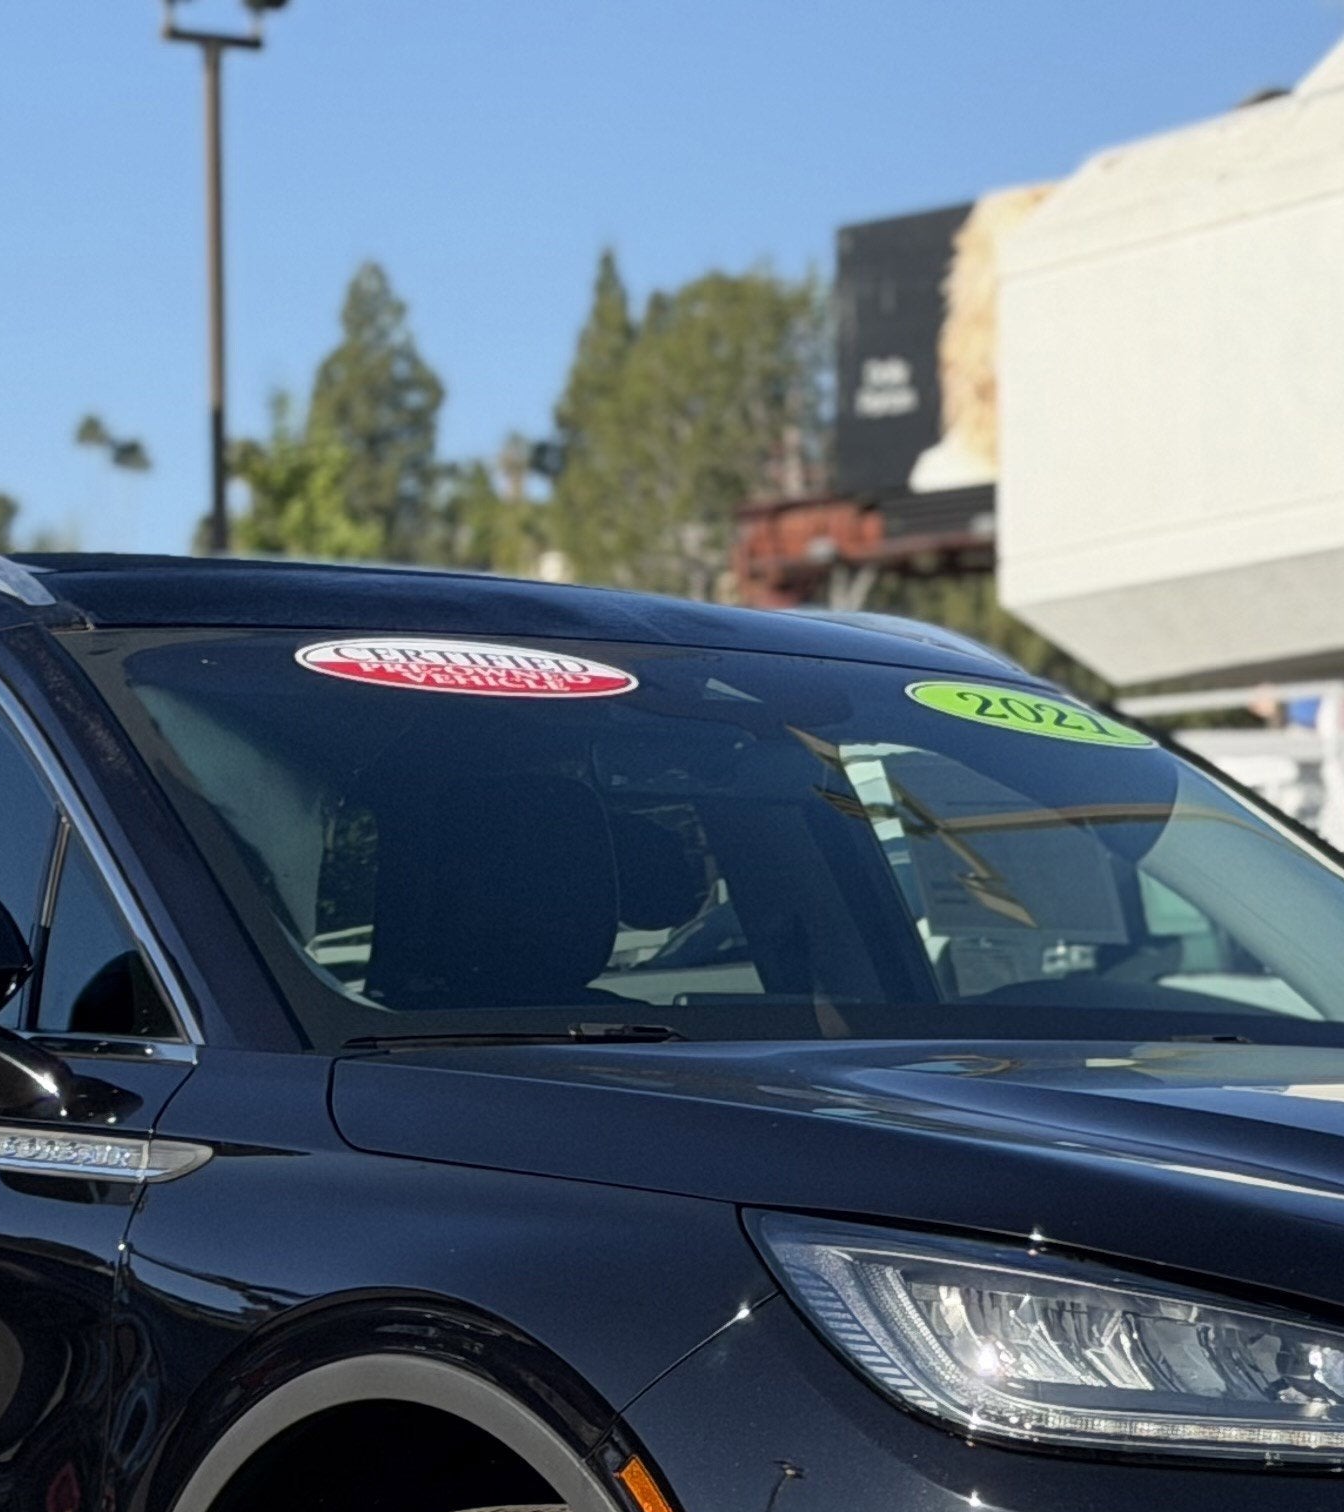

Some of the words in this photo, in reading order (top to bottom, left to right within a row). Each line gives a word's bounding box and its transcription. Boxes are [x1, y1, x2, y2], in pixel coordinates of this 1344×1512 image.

[333, 647, 589, 674] CERTIFIED
[358, 662, 592, 684] PRE-OWNED
[401, 671, 571, 692] VEHICLE
[956, 691, 1122, 738] 2021
